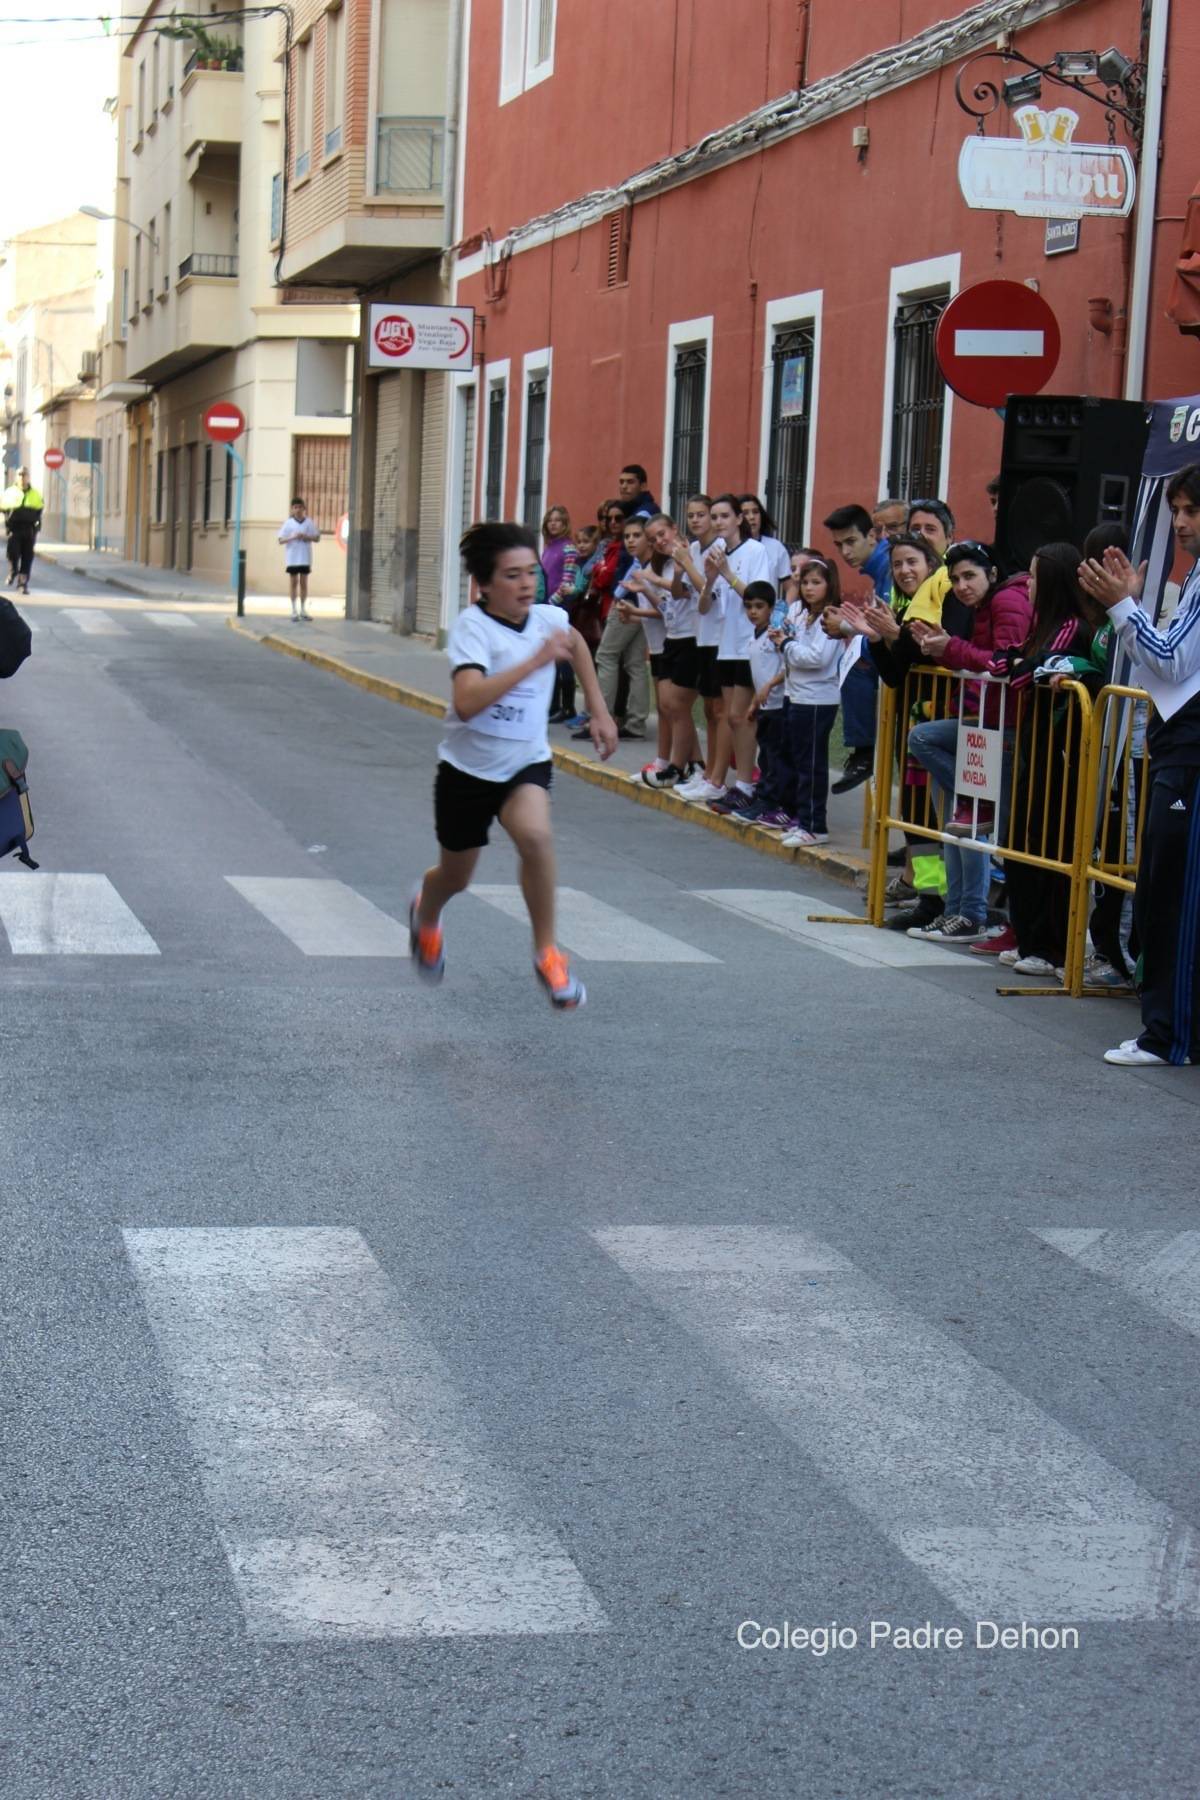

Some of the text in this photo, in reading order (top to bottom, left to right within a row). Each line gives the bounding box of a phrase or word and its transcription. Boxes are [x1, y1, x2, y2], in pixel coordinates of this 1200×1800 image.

[975, 156, 1123, 199] hou
[379, 321, 411, 338] UGT
[966, 733, 987, 750] POLICIA
[967, 752, 984, 768] LOCAL
[962, 769, 987, 787] NOVELDA
